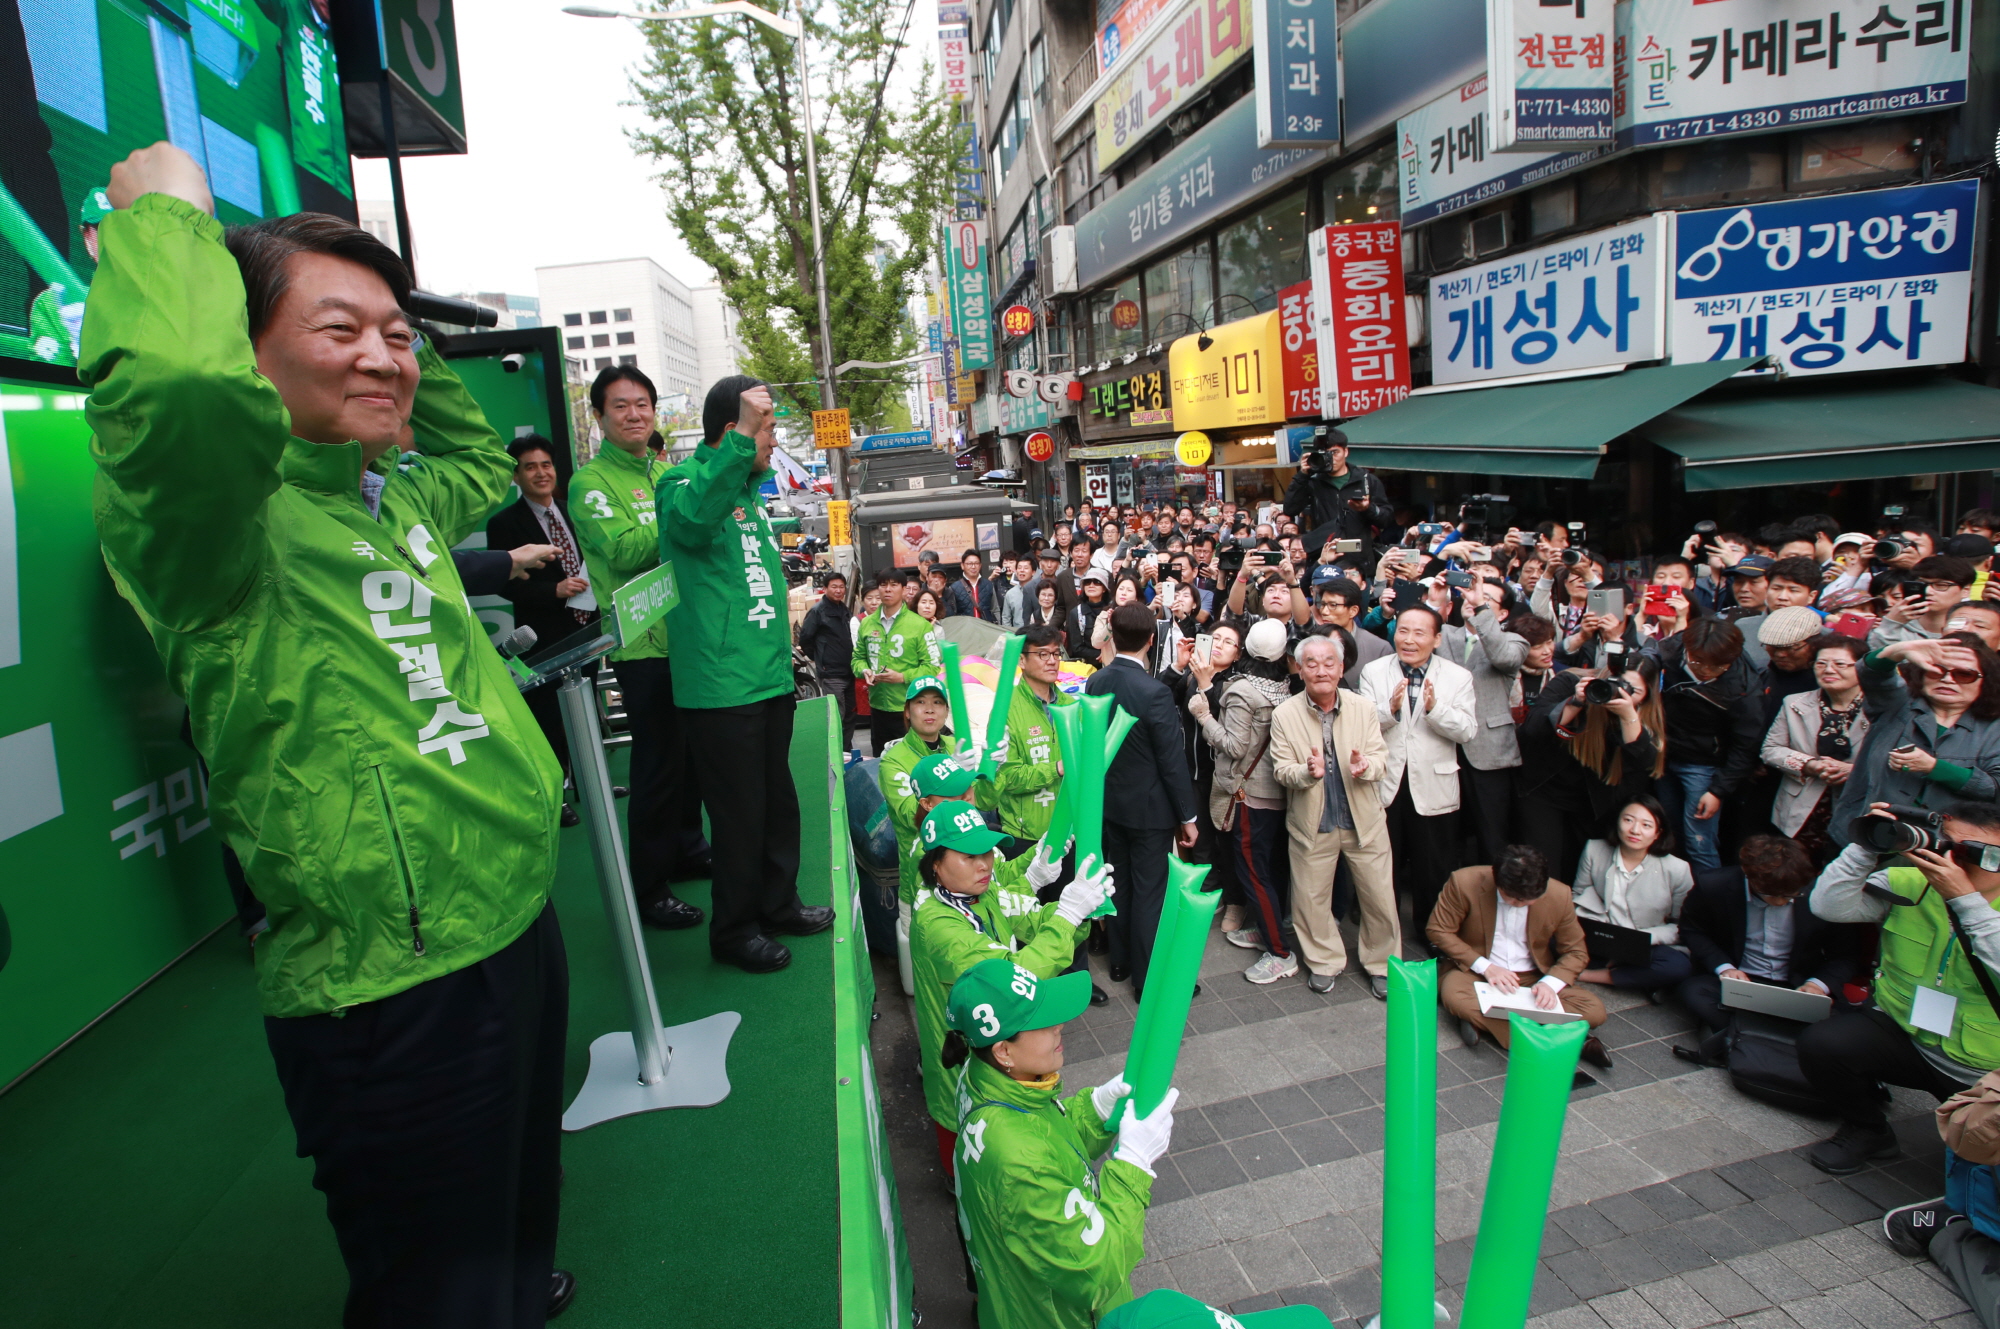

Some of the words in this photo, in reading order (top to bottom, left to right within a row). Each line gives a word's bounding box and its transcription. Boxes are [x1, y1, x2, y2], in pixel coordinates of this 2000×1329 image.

[1103, 30, 1120, 65] 3층
[1286, 18, 1320, 96] 치과
[1517, 33, 1606, 69] 전문점
[1688, 12, 1845, 84] 카메라
[1856, 0, 1962, 64] 수리
[943, 41, 968, 94] 전당포
[1637, 35, 1677, 110] 스마트
[1114, 90, 1143, 148] 황제
[1517, 99, 1611, 116] T:771-4330
[1654, 109, 1782, 141] T:771-4330
[1789, 85, 1950, 122] smartcamera.kr
[1430, 112, 1488, 175] 카메
[1516, 121, 1612, 140] smartcamera.kr
[1401, 133, 1422, 205] 스마트
[1128, 180, 1173, 243] 김기홍
[1179, 156, 1215, 209] 치과
[1436, 179, 1506, 214] T:771-4330
[1332, 230, 1396, 256] 중국관
[1757, 208, 1960, 272] 명가안경
[1438, 277, 1473, 301] 계산기
[1486, 266, 1526, 292] 면도기
[1543, 252, 1588, 279] 드라이
[1608, 231, 1646, 258] 잡화
[960, 271, 989, 363] 삼성약국
[1446, 264, 1640, 371] 개성사
[1693, 295, 1742, 317] 계산기
[1761, 289, 1810, 311] 면도기
[1831, 283, 1882, 304] 드라이
[1902, 277, 1939, 300] 잡화
[1006, 311, 1031, 331] 보청기
[1340, 259, 1396, 383] 중화요리
[1708, 299, 1933, 374] 개성사
[1130, 370, 1163, 412] 안경
[1222, 349, 1262, 398] 101
[1341, 384, 1408, 414] 755-7116
[814, 412, 847, 429] 불법주정차
[816, 429, 848, 446] 무인단속중
[1029, 438, 1053, 457] 보청기
[1185, 450, 1205, 459] 101
[584, 490, 614, 519] 3
[741, 533, 776, 629] 안철수
[890, 634, 904, 658] 3
[893, 772, 913, 797] 3
[925, 819, 936, 844] 3
[972, 1003, 1001, 1038] 3
[1064, 1187, 1105, 1246] 3
[1913, 1210, 1935, 1227] N
